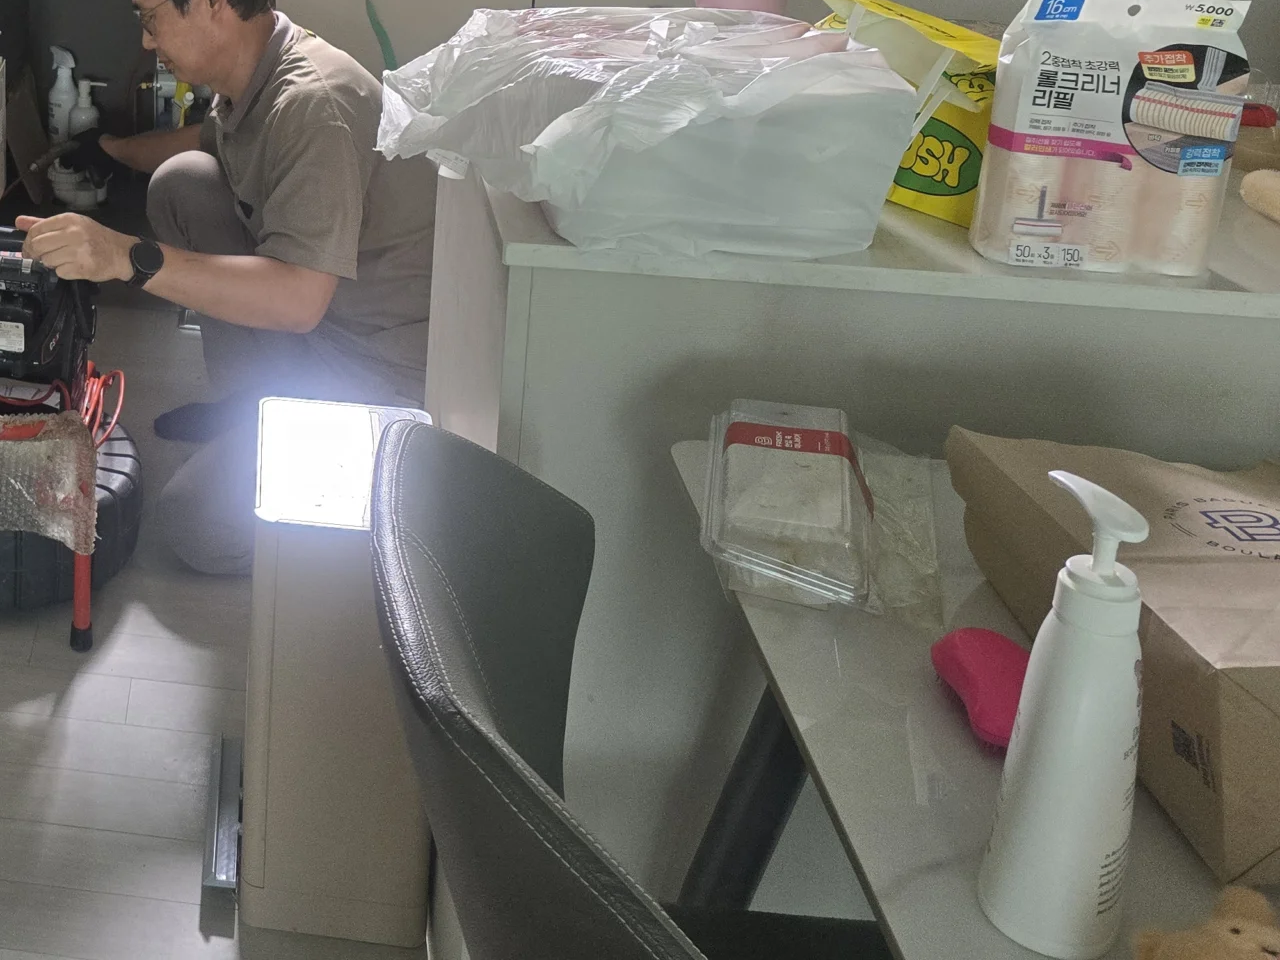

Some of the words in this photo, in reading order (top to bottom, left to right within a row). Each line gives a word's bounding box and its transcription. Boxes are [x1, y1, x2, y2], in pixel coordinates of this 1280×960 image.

[1084, 60, 1120, 71] 초강력
[1037, 69, 1120, 95] 롤크리너
[1032, 89, 1075, 110] 리필
[1163, 502, 1189, 520] PARIS
